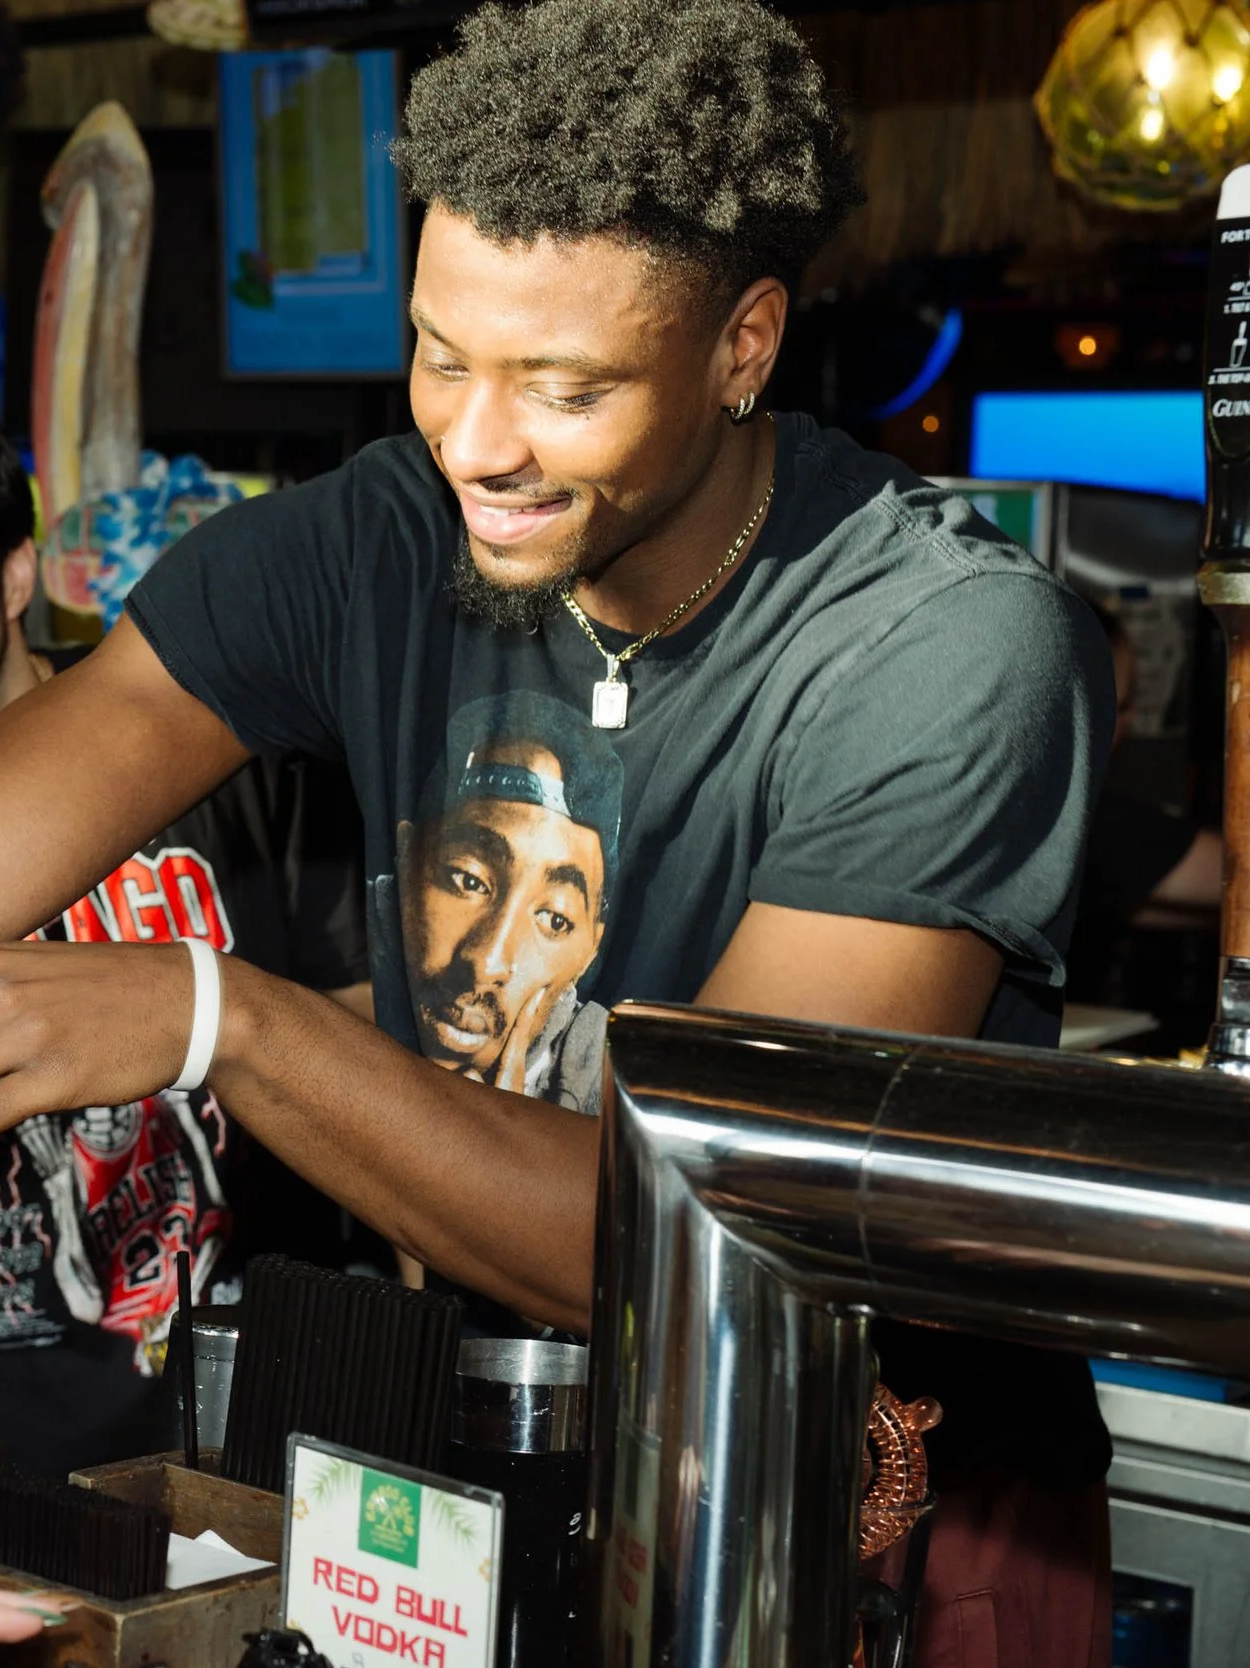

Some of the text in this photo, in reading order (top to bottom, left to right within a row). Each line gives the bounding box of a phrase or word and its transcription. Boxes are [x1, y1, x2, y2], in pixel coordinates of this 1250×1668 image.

[313, 1556, 468, 1637] RED BULL
[332, 1605, 445, 1668] VODKA
